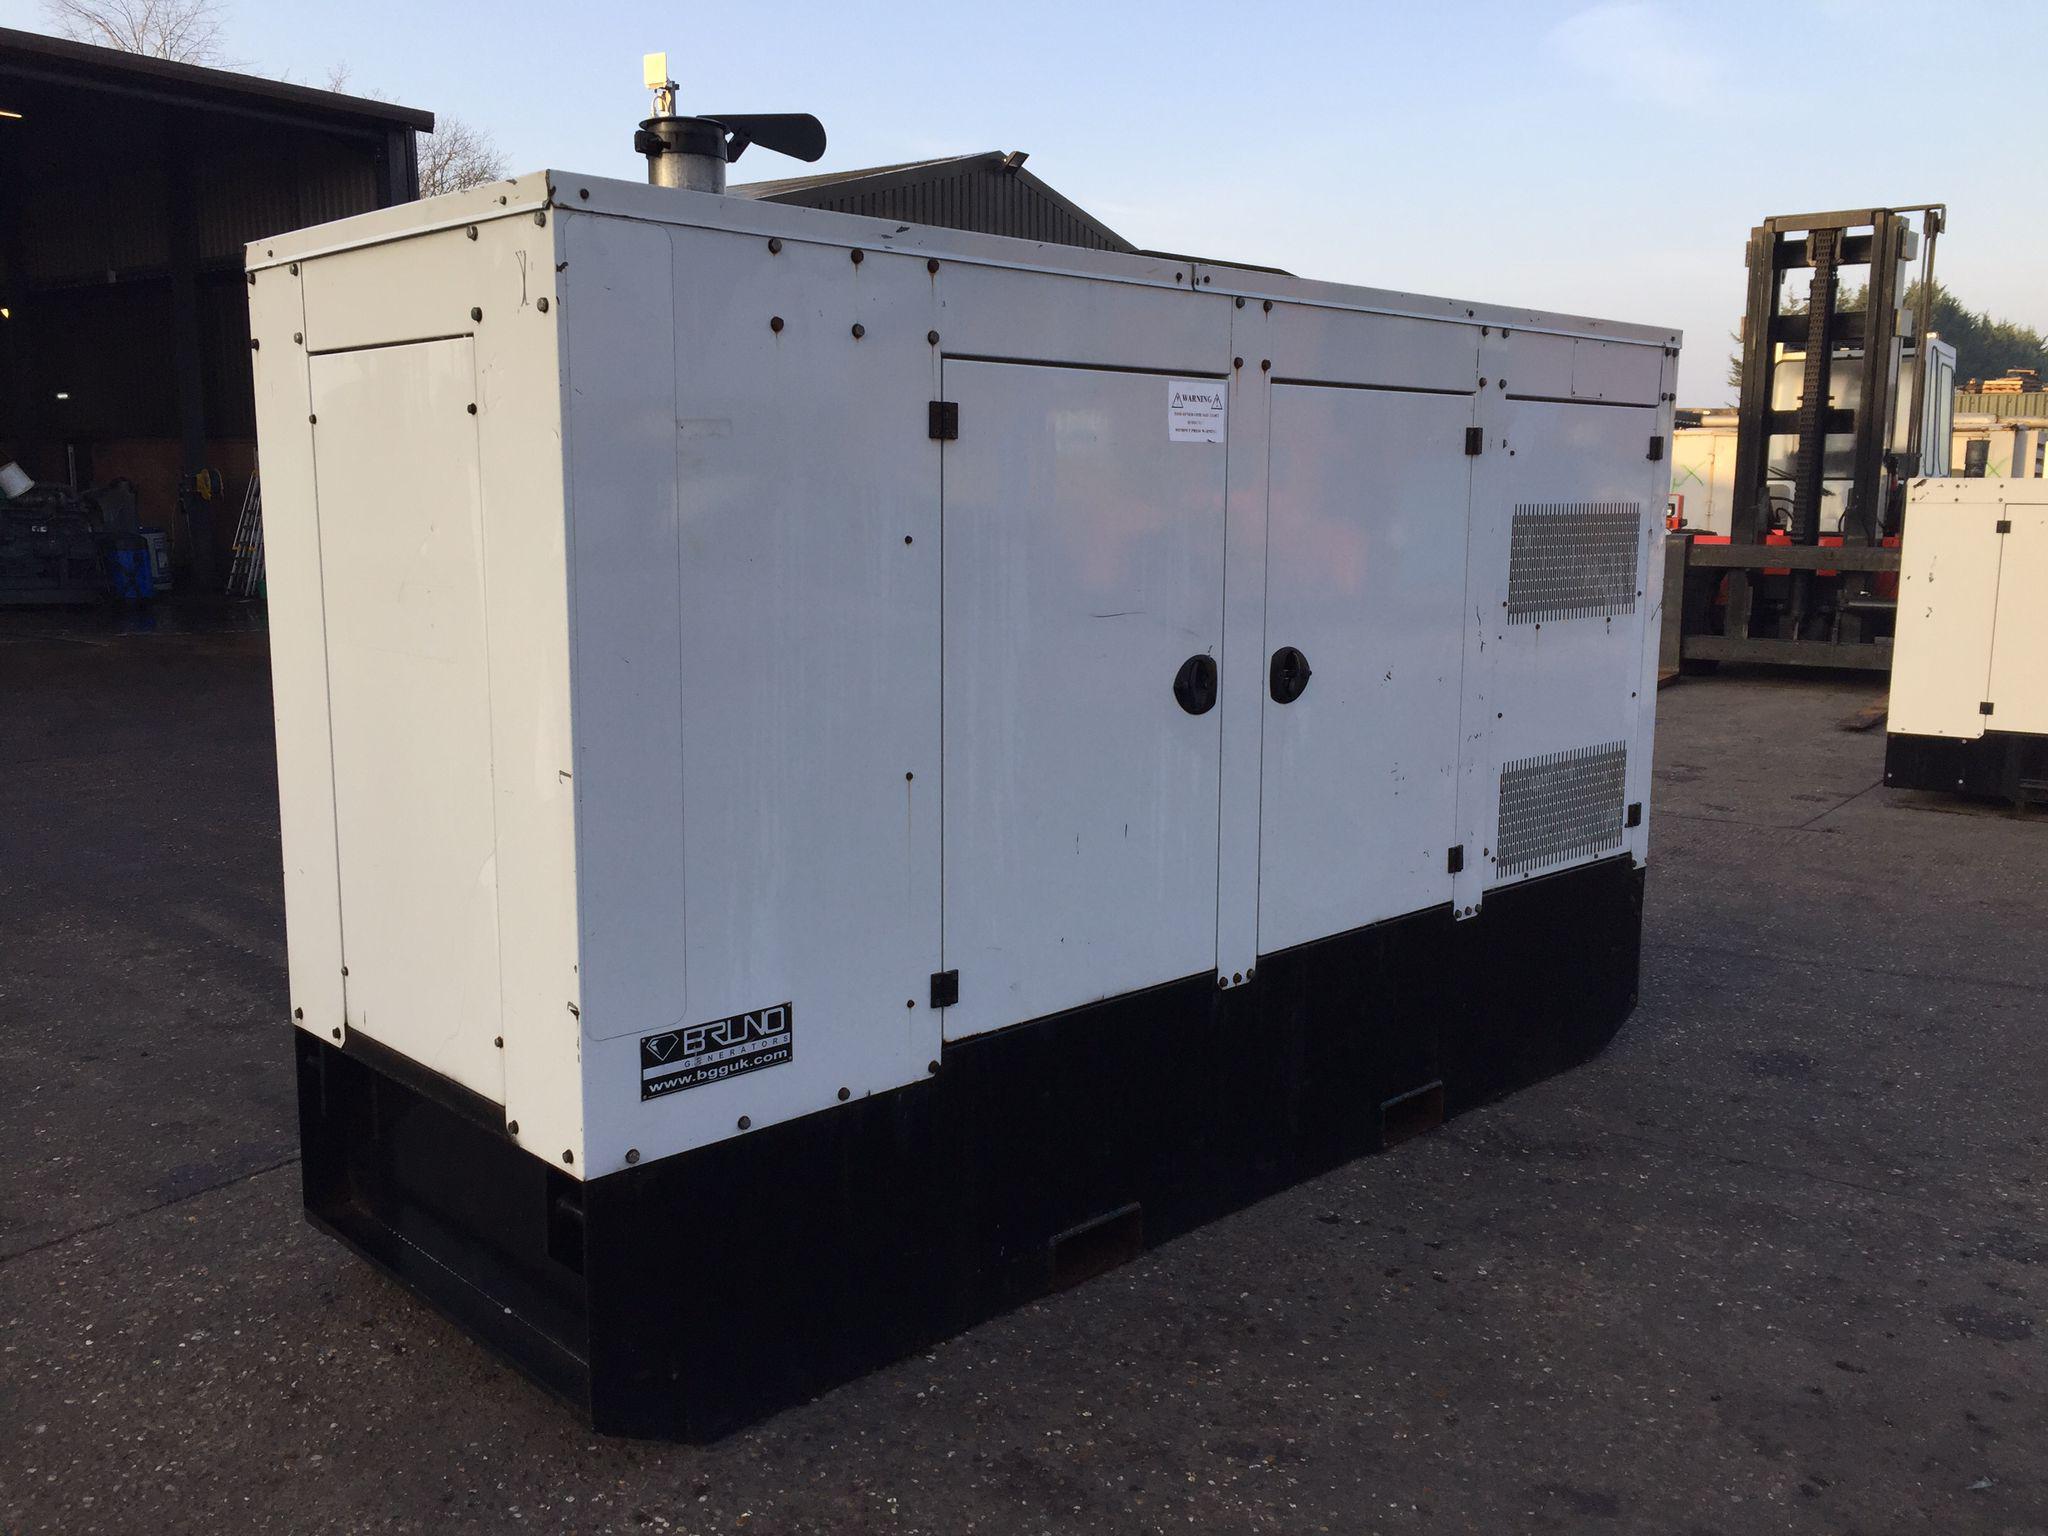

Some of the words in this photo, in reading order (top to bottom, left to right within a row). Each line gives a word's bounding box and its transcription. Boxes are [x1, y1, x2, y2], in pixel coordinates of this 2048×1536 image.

[1182, 394, 1212, 403] WARNING
[684, 1007, 784, 1055] BRUNO
[649, 1049, 788, 1092] www.bgguk.com
[685, 1035, 790, 1068] GENERATORS
